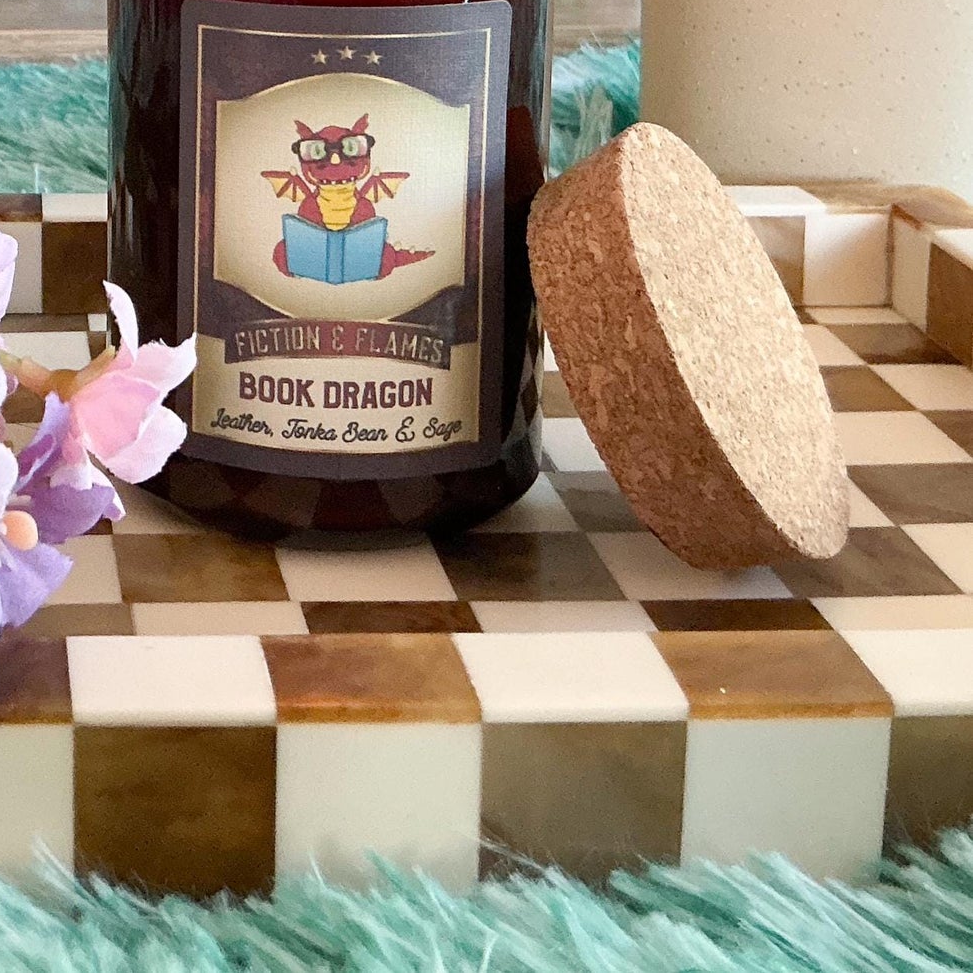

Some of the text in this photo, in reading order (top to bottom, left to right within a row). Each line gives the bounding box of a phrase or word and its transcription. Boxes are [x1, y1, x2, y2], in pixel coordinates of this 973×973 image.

[234, 326, 320, 357] FICTION
[355, 328, 444, 363] FLAMES
[239, 372, 433, 409] BOOK DRAGON
[210, 408, 463, 443] Leather, Tonka Bean & Sage
